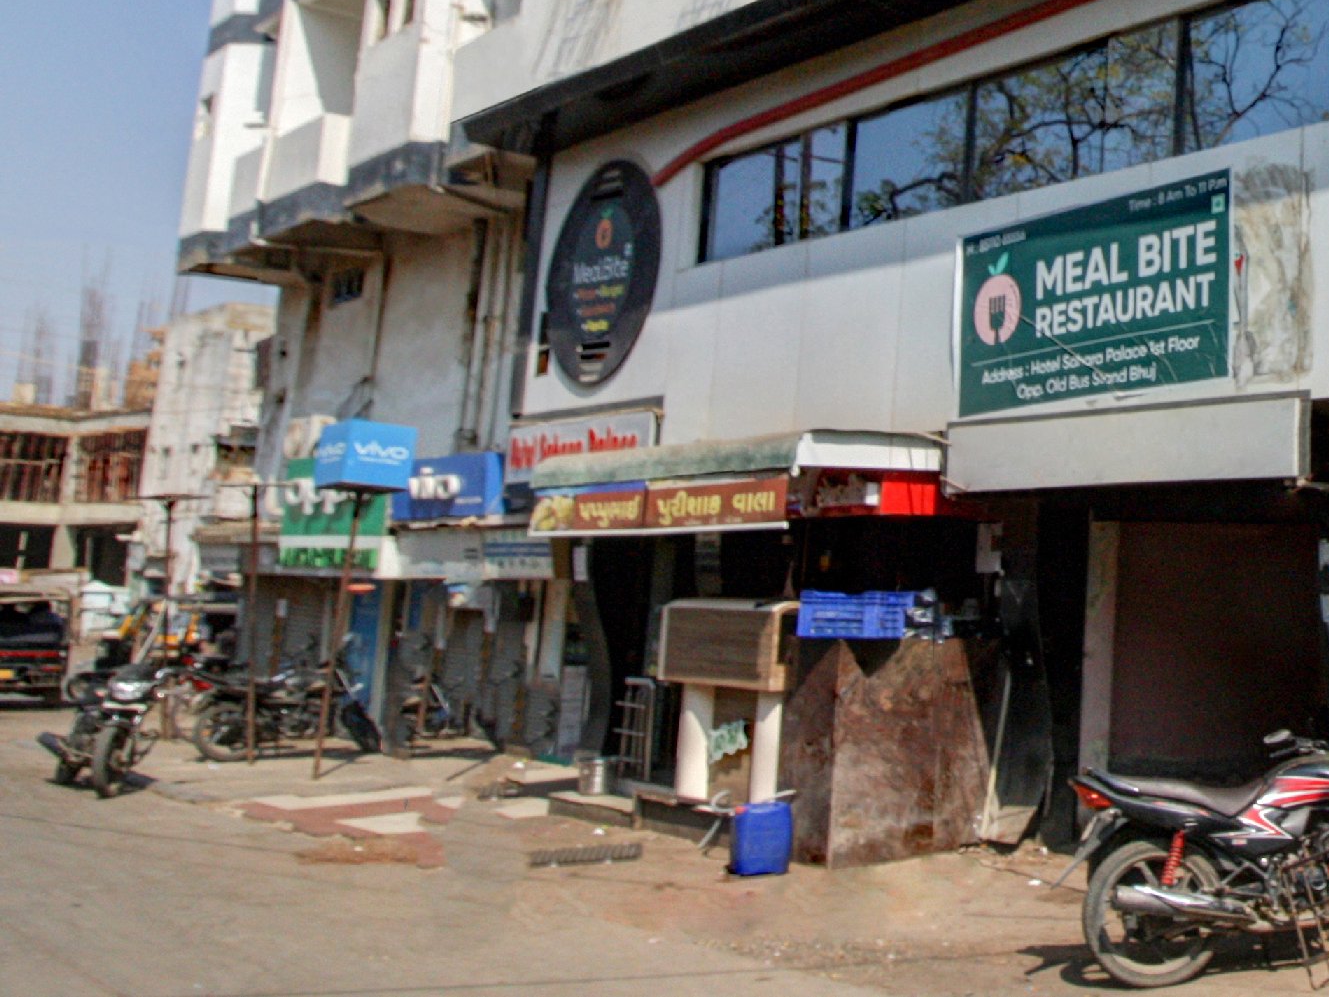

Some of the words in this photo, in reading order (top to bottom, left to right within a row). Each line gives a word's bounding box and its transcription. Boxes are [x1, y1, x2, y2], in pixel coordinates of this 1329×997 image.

[1035, 241, 1129, 301] MEAL
[1137, 219, 1217, 279] BITE
[1035, 272, 1215, 339] RESTAURANT
[1031, 356, 1061, 375] Hotel
[1167, 335, 1201, 353] Floor
[1045, 377, 1067, 394] Old
[1069, 373, 1090, 390] Bus
[1129, 362, 1157, 382] Bhuj
[354, 440, 410, 460] vivo
